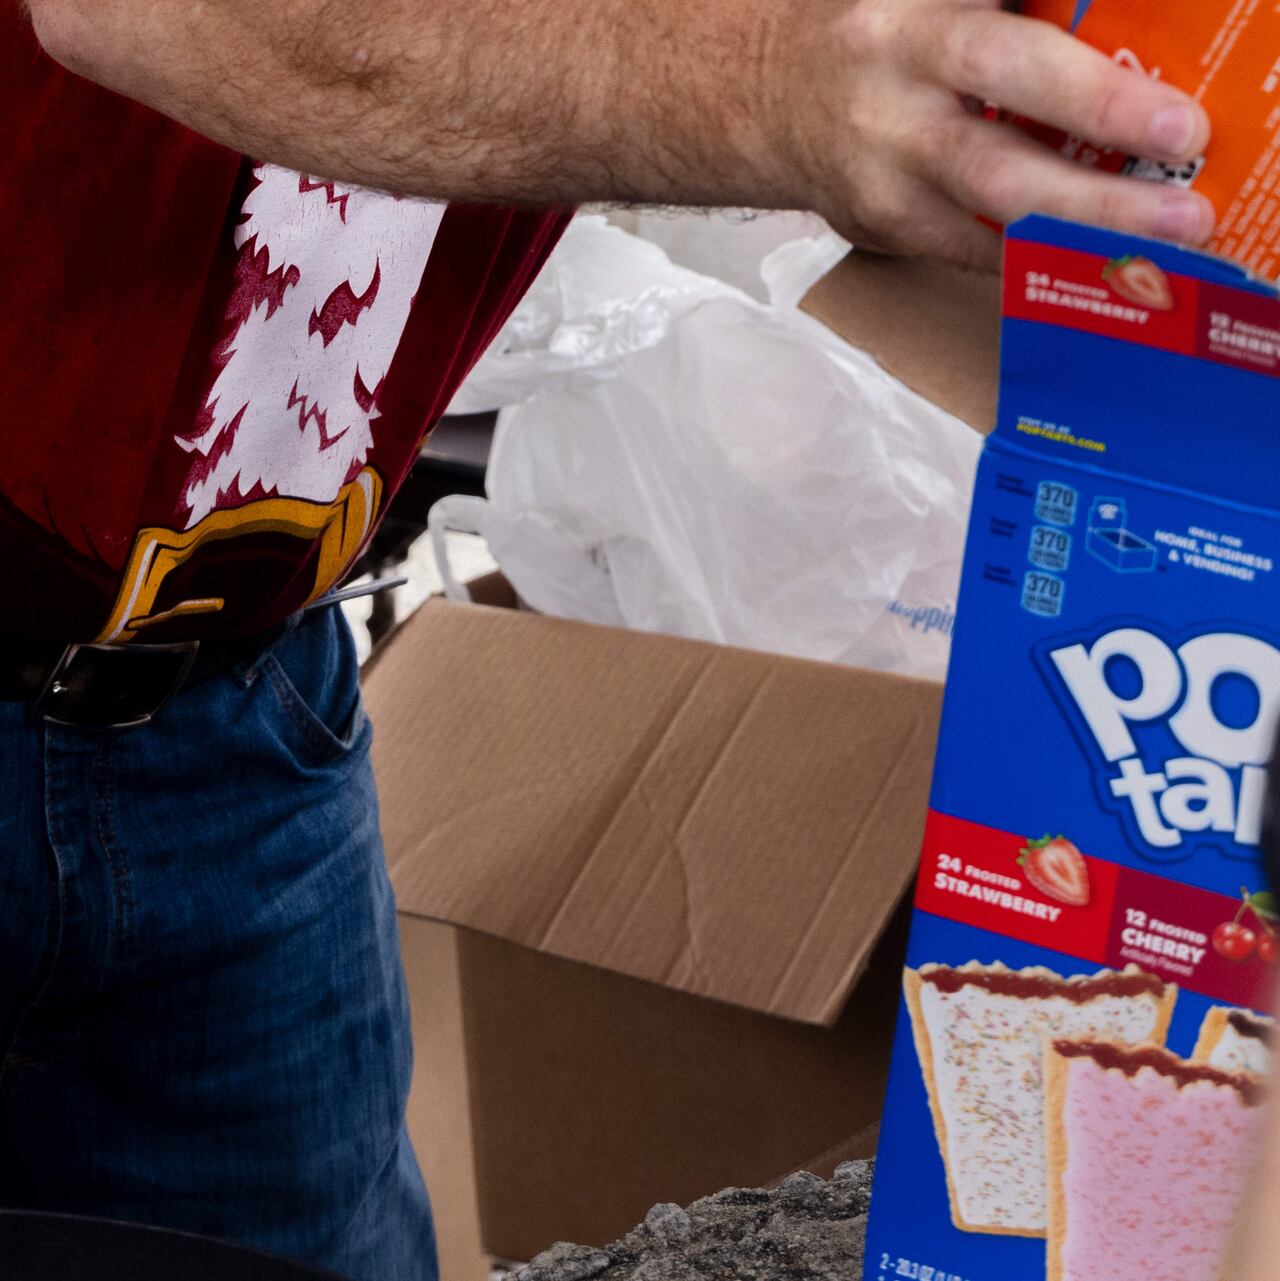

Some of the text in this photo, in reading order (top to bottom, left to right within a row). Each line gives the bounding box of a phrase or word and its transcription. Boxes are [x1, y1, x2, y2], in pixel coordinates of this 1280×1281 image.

[1025, 286, 1151, 325] STRAWBERRY
[1038, 483, 1075, 507] 370
[1032, 527, 1069, 552] 370
[1203, 542, 1273, 572] BUSINESS
[1025, 572, 1062, 597] 370
[936, 852, 1022, 892] 24 FROSTED
[933, 872, 1063, 923] STRAWBERRY
[1124, 907, 1208, 945] 12 FROSTED
[1120, 927, 1206, 966] CHERRY
